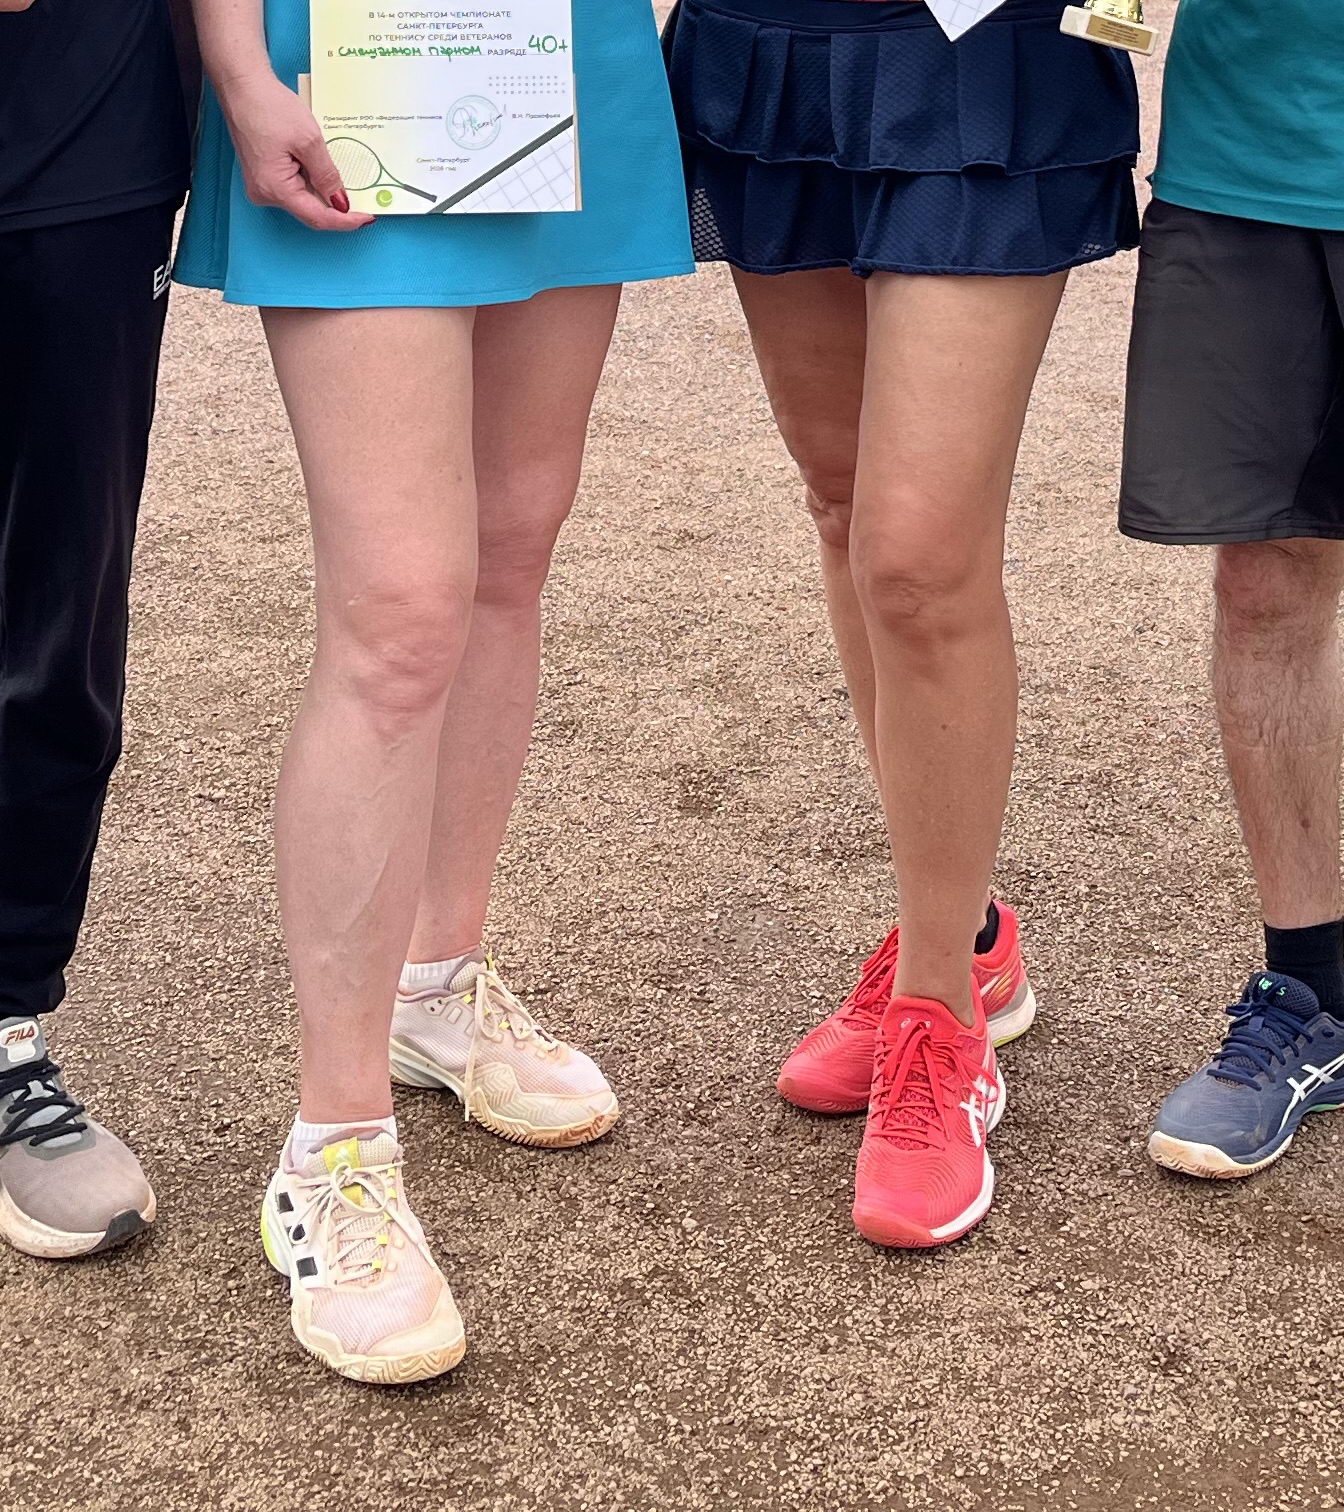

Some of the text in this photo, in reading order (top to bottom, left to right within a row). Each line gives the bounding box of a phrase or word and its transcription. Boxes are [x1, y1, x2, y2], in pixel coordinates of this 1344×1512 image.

[397, 11, 448, 19] ОТКРЫТОМ
[450, 10, 512, 19] ЧЕМПИОНАТЕ
[397, 22, 484, 30] САНКТ-ПЕТЕРБУРГА
[384, 34, 426, 42] ТЕННИСУ
[427, 33, 458, 42] СРЕДИ
[460, 33, 513, 41] ВЕТЕРАНОВ
[487, 48, 527, 56] РАЗРЯДЕ
[528, 34, 568, 54] 40+
[6, 1024, 36, 1045] FILA
